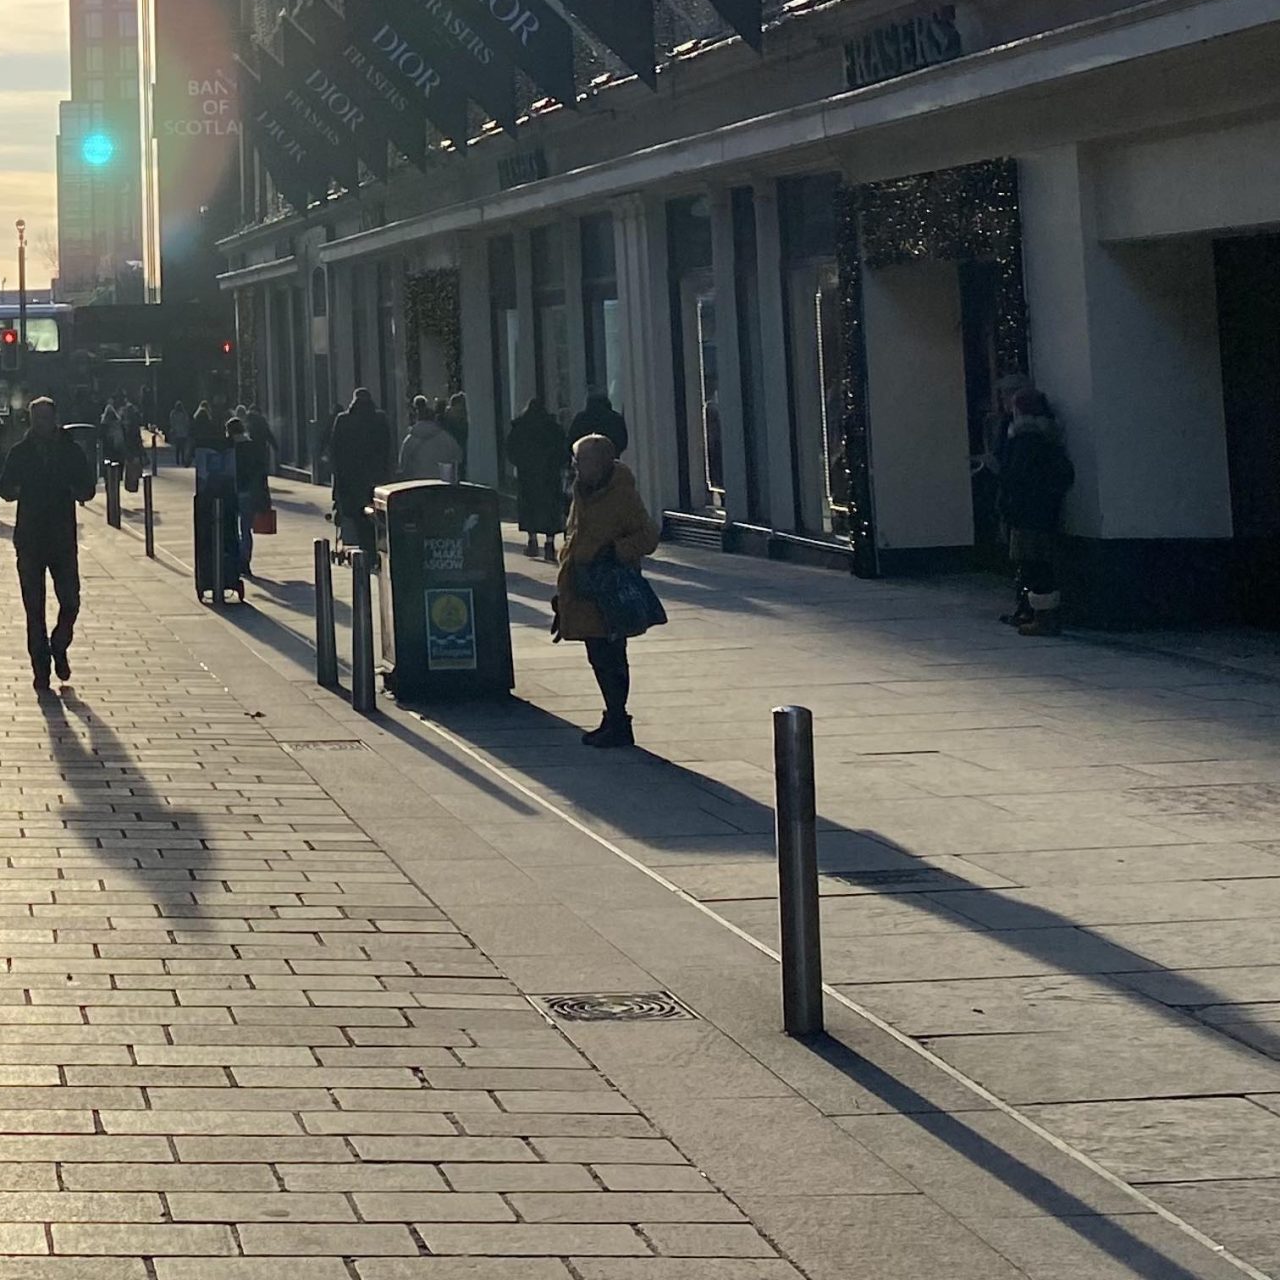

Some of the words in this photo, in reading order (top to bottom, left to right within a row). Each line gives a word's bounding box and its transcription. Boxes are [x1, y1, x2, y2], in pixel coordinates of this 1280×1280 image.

[371, 23, 441, 99] DIOR
[342, 45, 409, 112] FRASERS
[188, 80, 230, 95] BAN
[202, 99, 231, 116] OF
[304, 67, 365, 133] DIOR
[164, 120, 239, 136] SCOTLA
[256, 110, 308, 164] DIOR
[433, 548, 465, 559] MAKE
[422, 559, 465, 570] ASGOW
